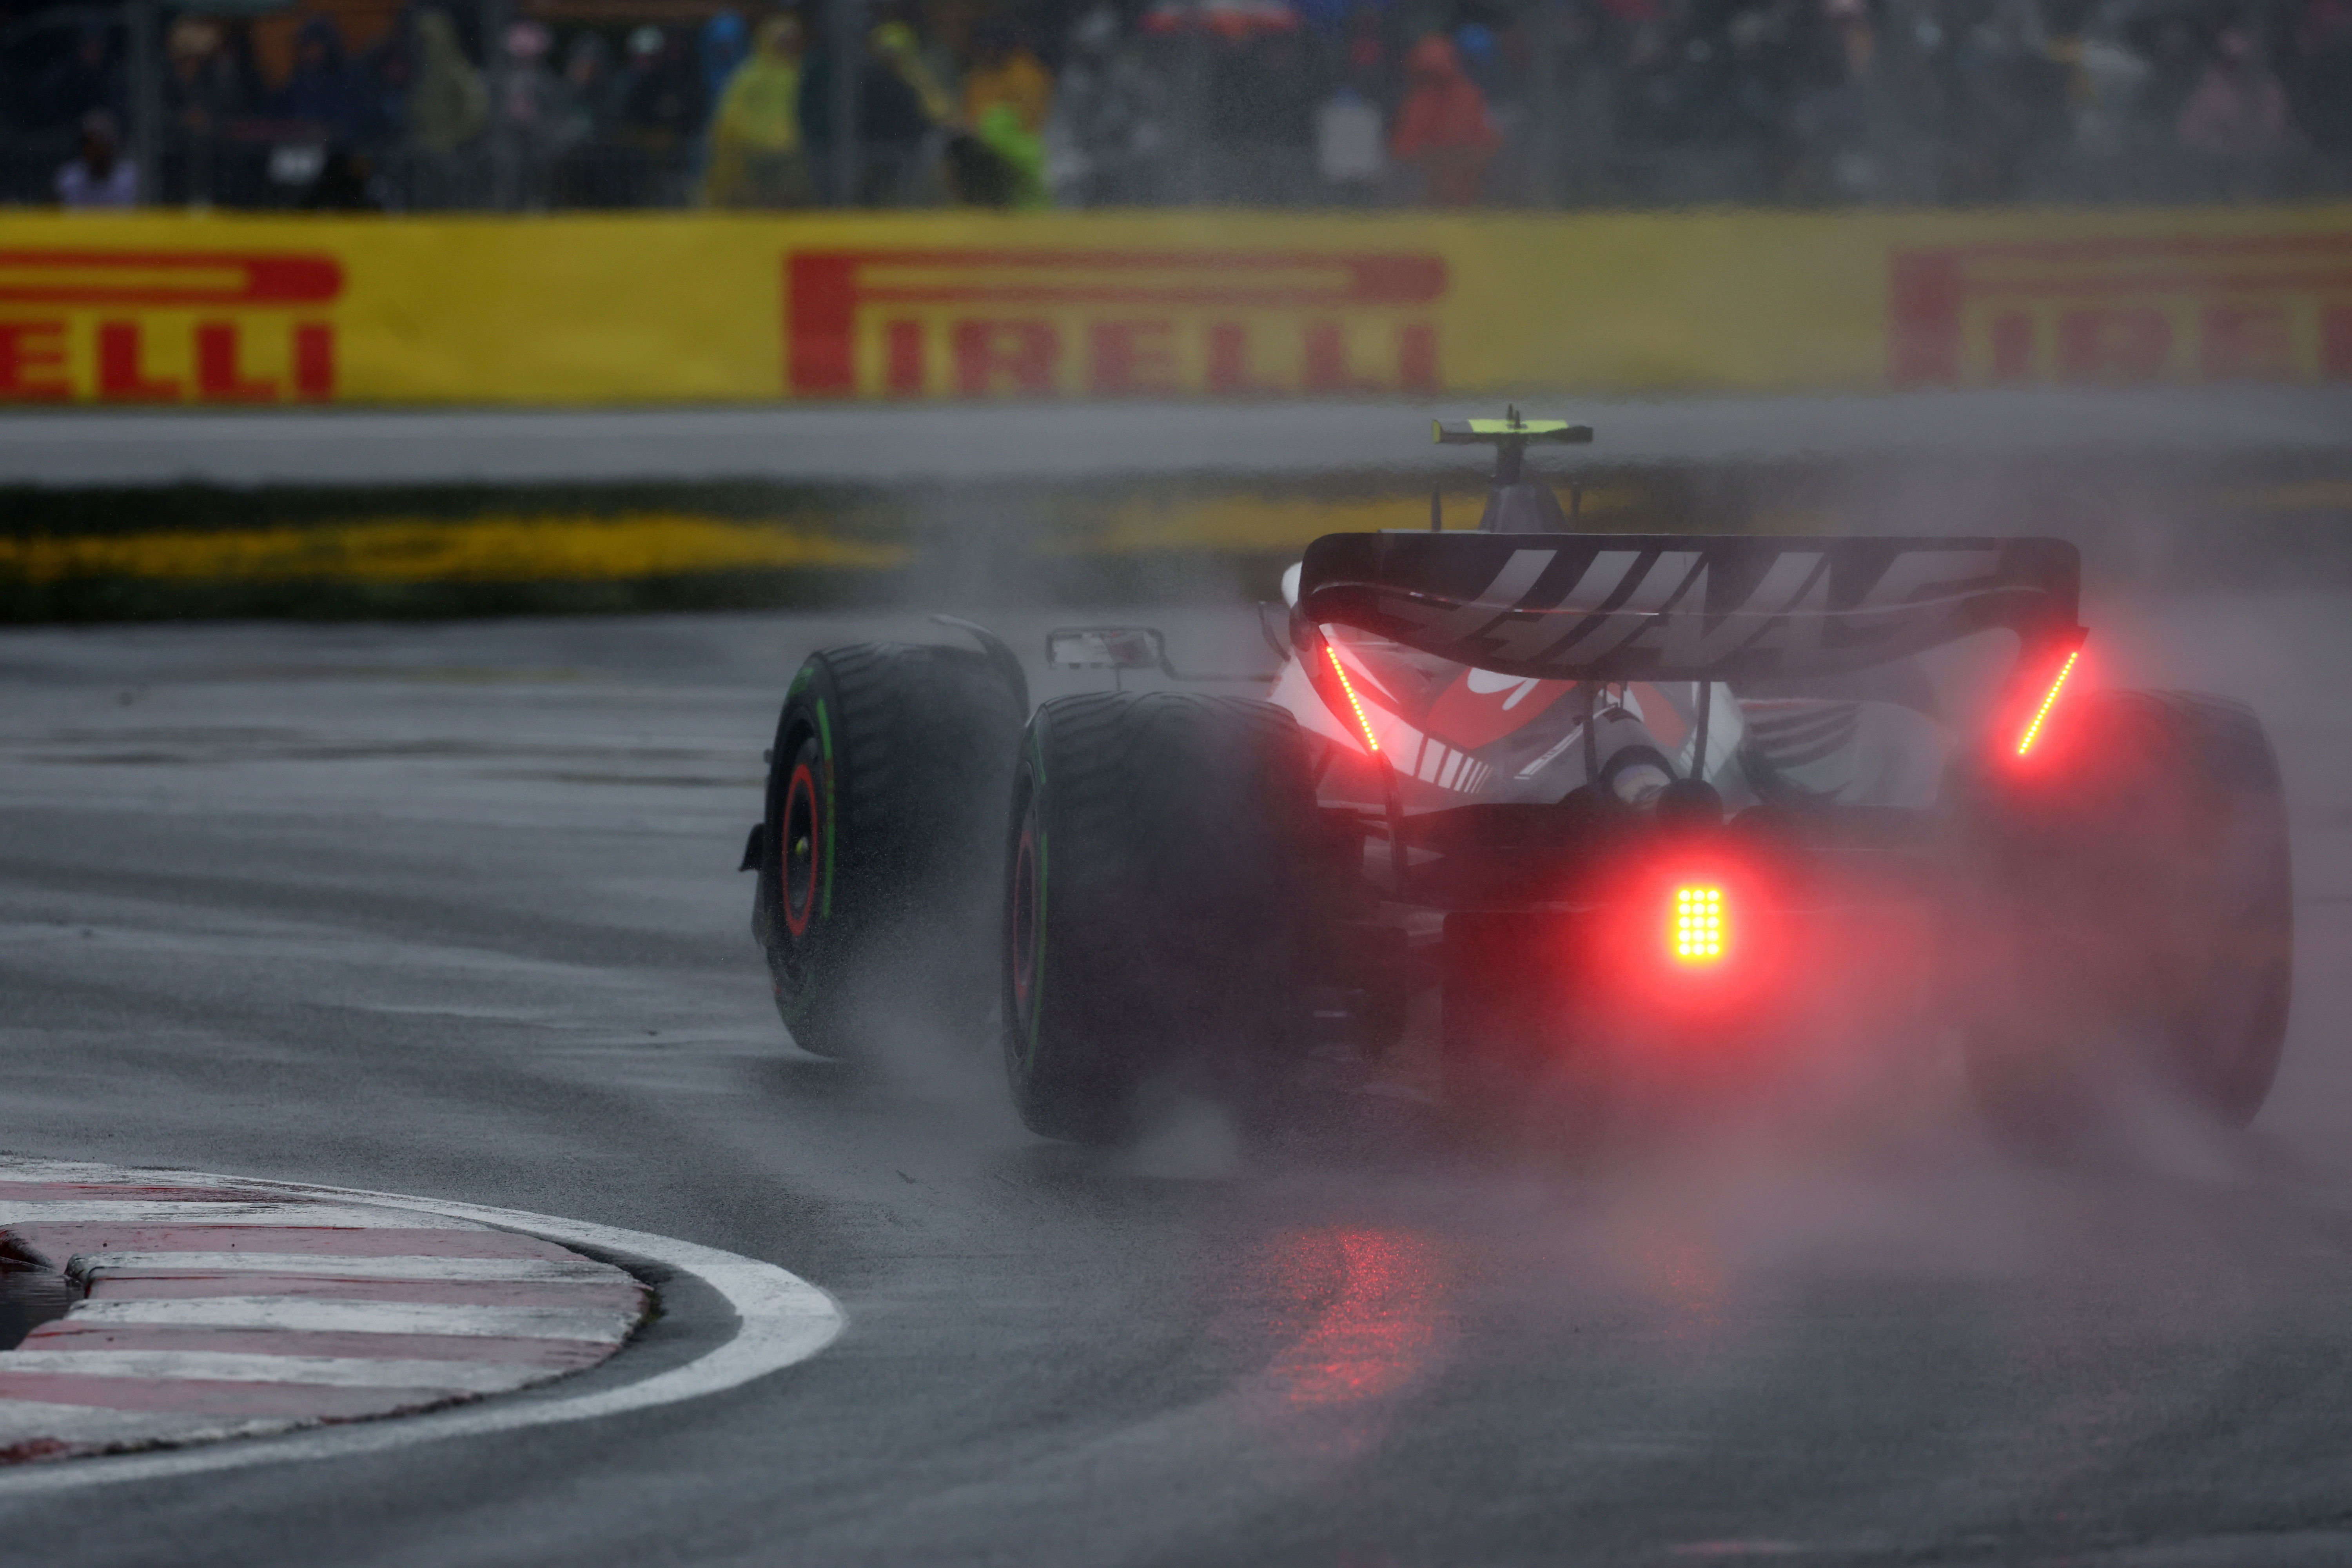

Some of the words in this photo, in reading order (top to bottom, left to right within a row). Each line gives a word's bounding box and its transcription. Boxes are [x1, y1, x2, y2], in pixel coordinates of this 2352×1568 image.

[0, 249, 343, 401] ELLI
[786, 250, 1447, 397] PIRELLI
[1889, 234, 2352, 388] PIRE
